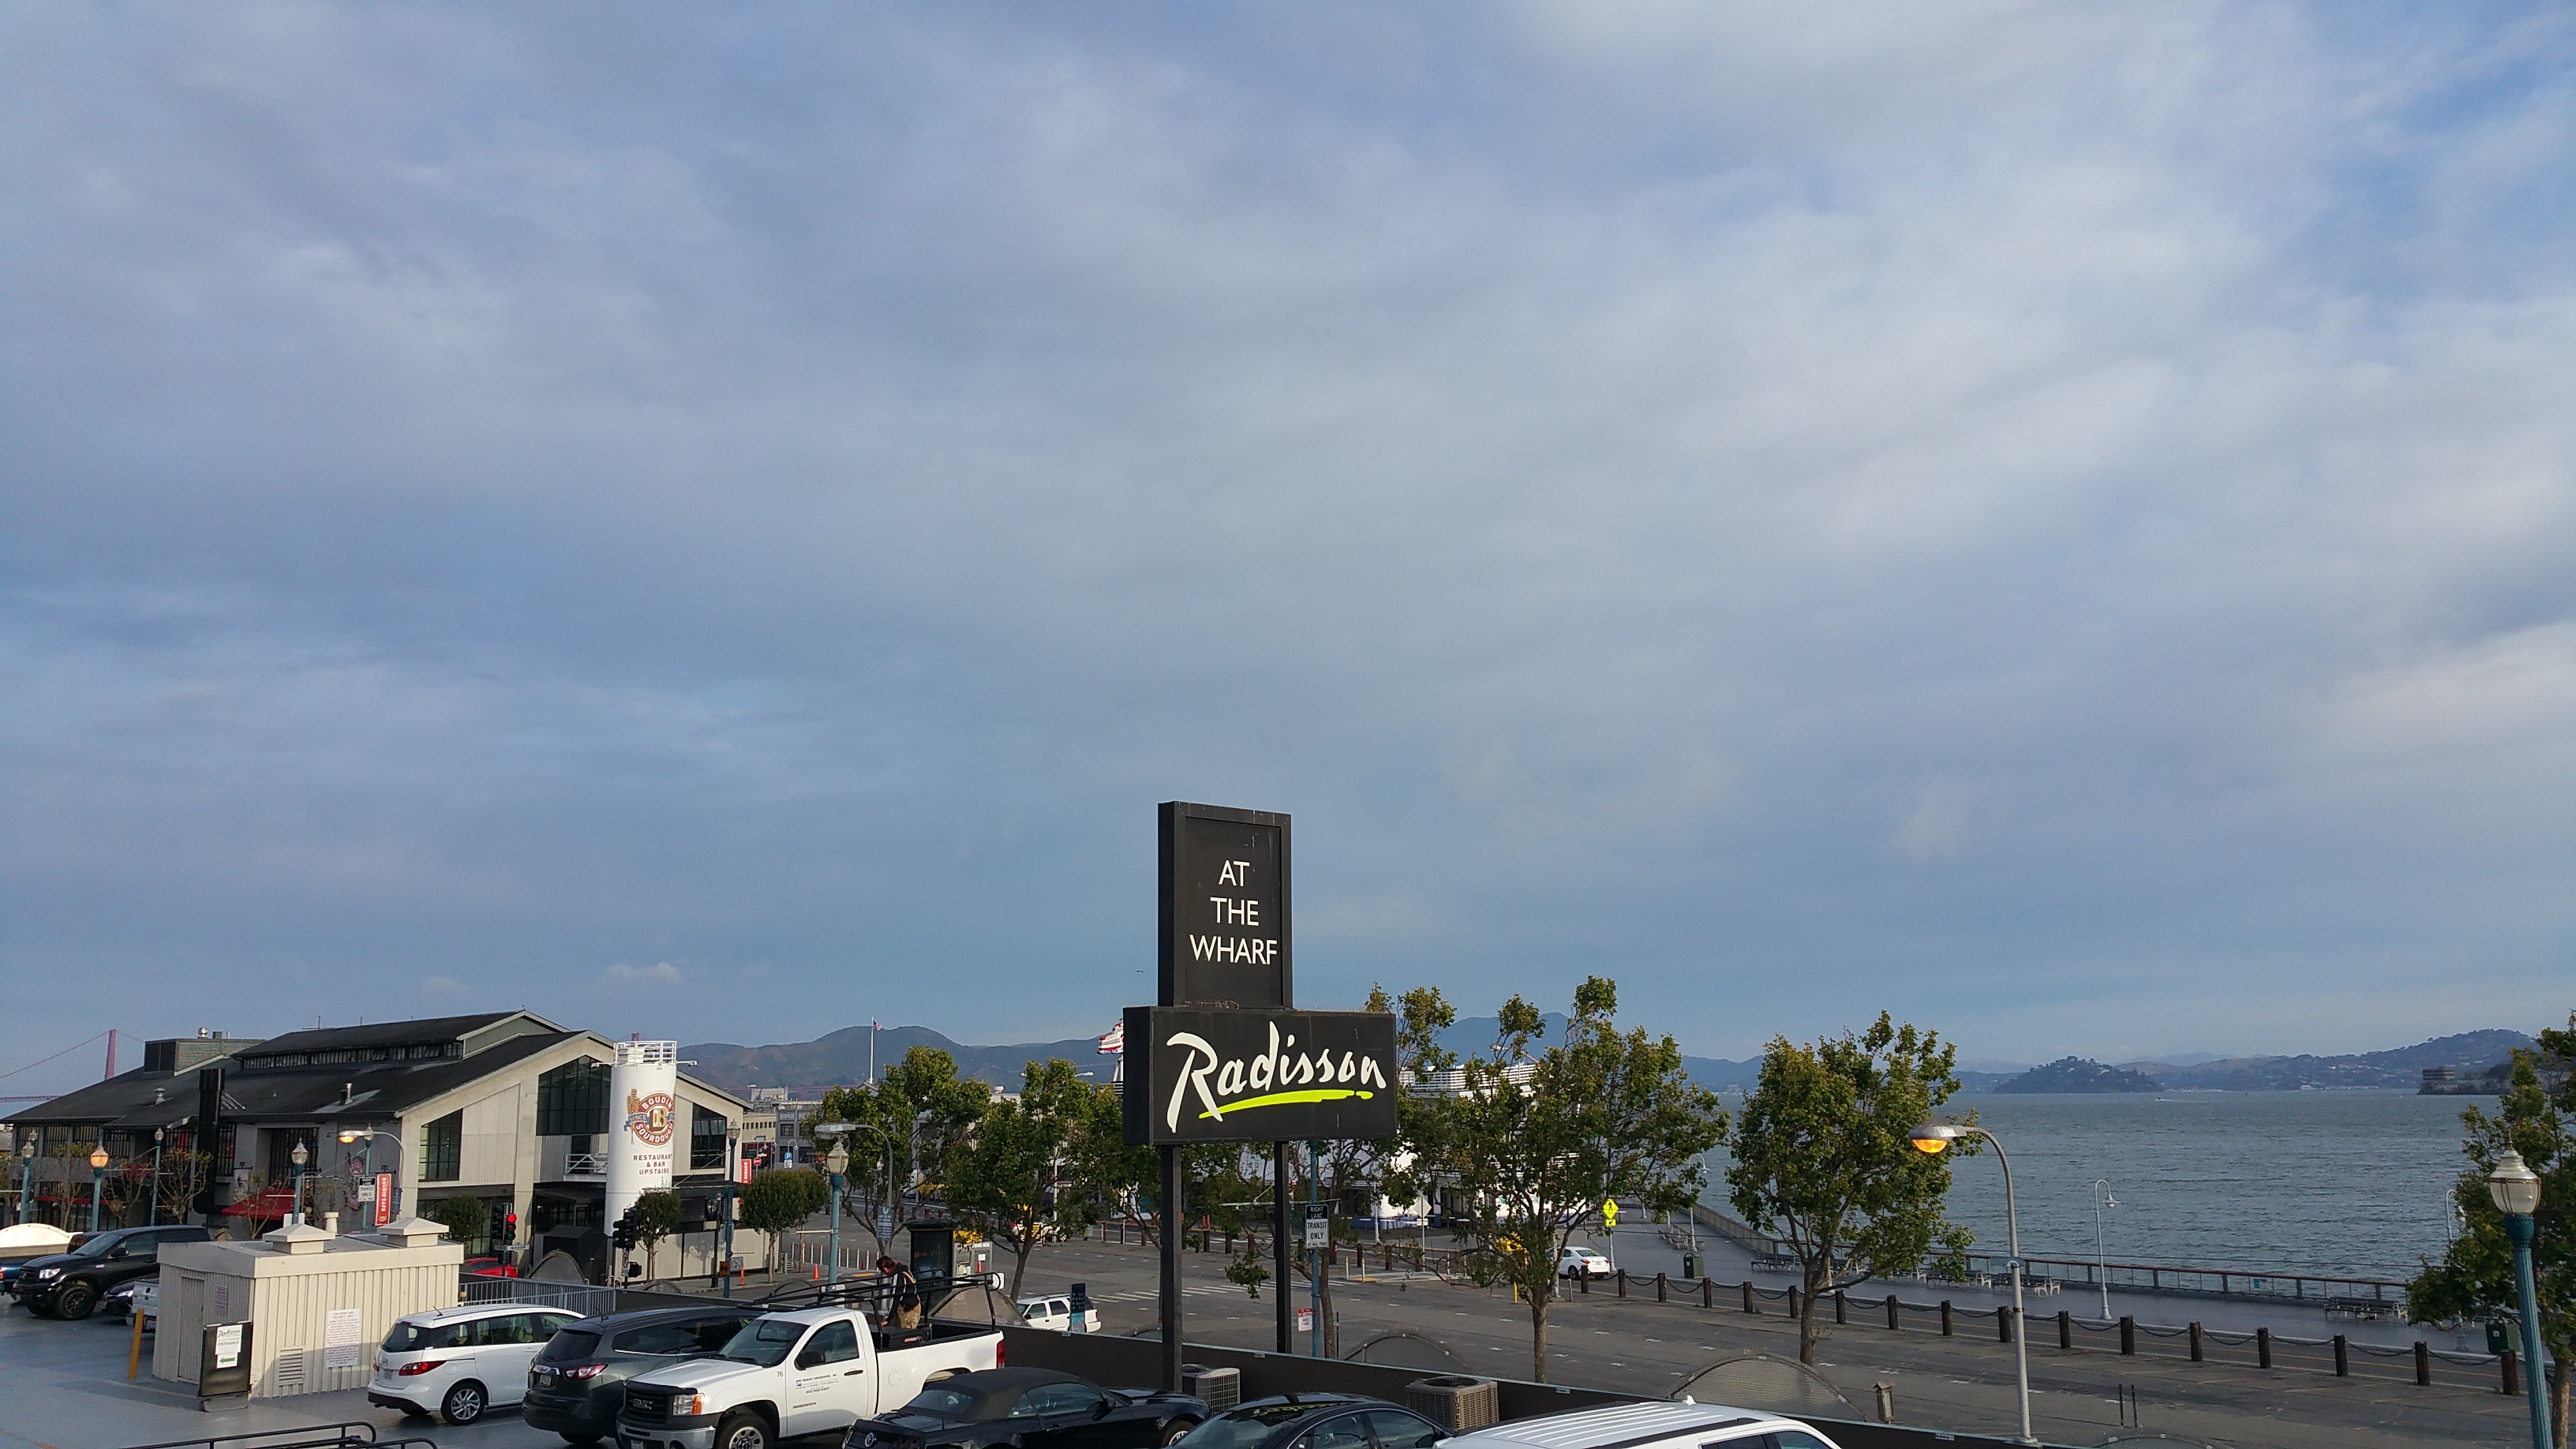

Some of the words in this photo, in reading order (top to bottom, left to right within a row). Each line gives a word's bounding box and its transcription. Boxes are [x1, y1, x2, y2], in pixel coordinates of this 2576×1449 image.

[1218, 859, 1250, 887] AT
[1210, 897, 1260, 927] THE
[1189, 934, 1278, 965] WHARF
[1166, 1020, 1387, 1134] Radisson
[641, 1095, 673, 1110] BOUDIN
[635, 1123, 674, 1143] SOURDOUGH
[218, 1329, 241, 1338] Radisson
